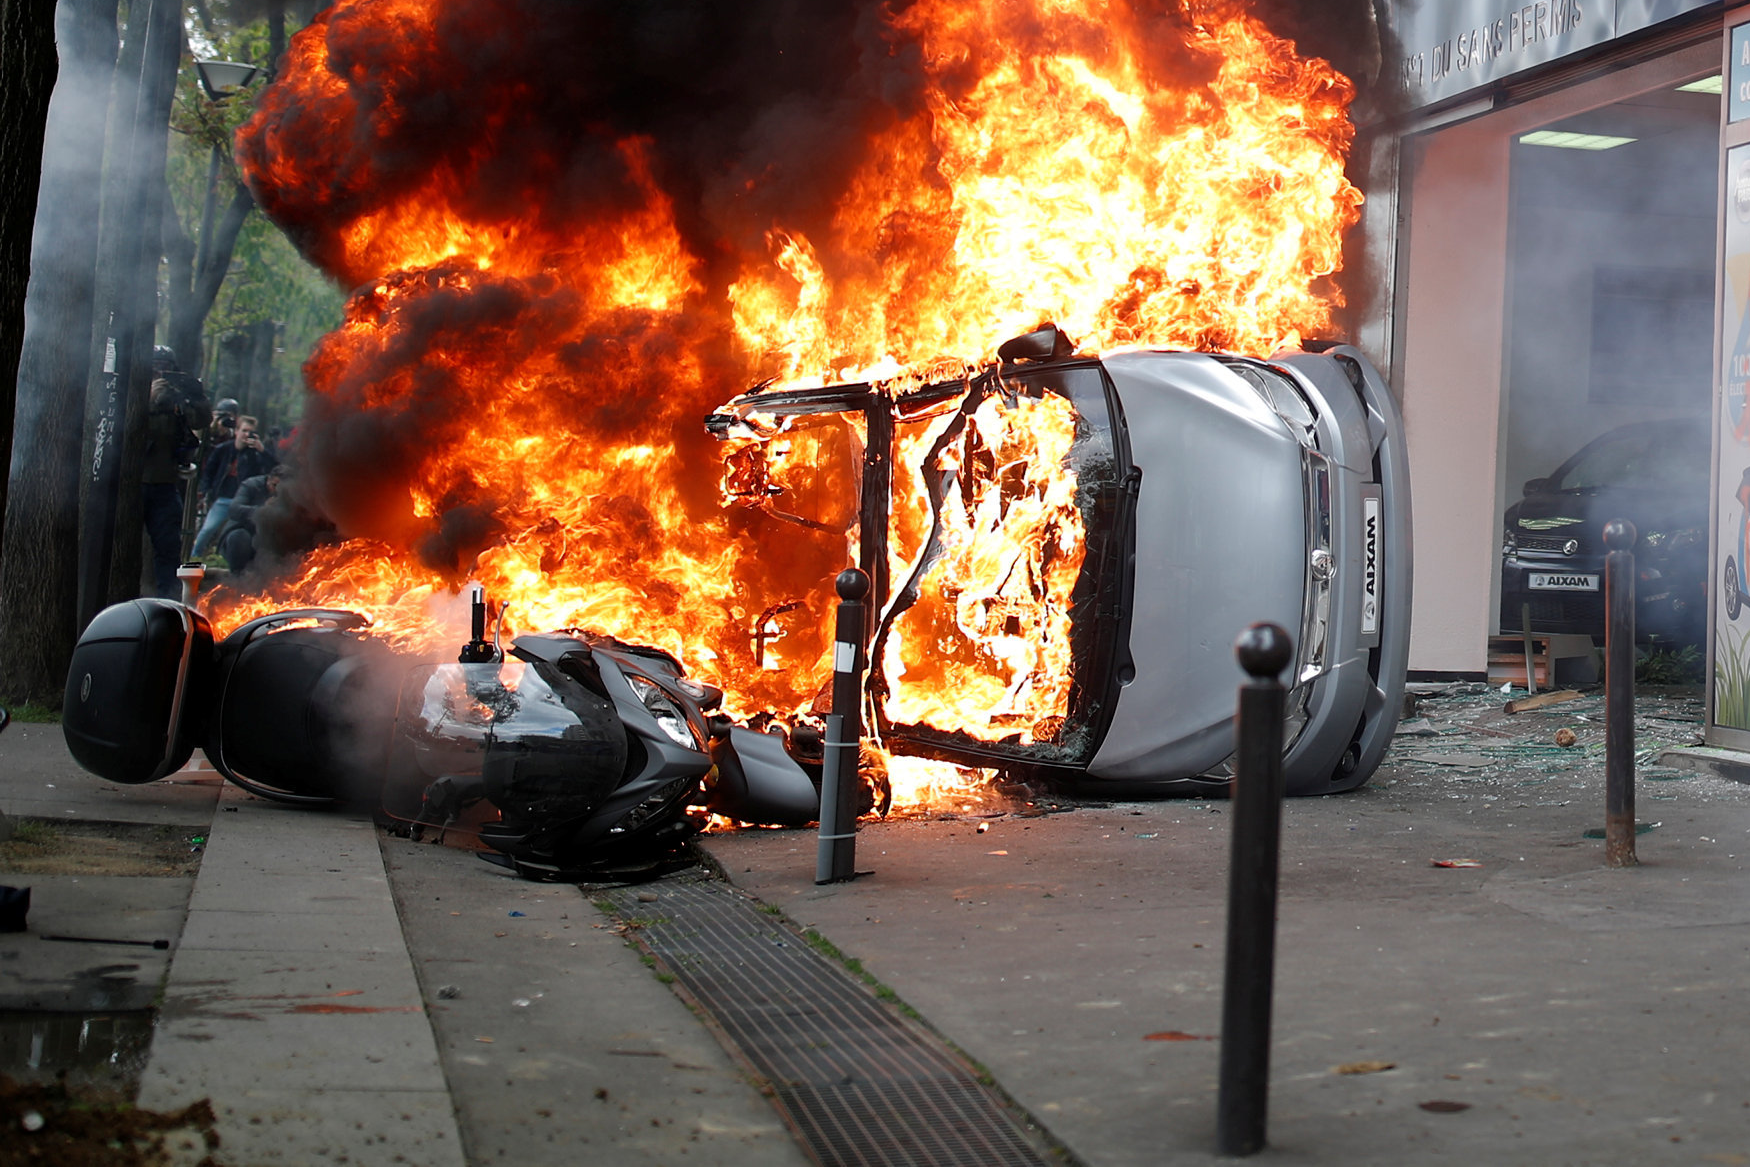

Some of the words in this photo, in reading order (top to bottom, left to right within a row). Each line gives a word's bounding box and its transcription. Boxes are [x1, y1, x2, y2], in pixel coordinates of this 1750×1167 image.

[1432, 40, 1452, 83] DU
[1456, 18, 1504, 72] SANS
[1366, 515, 1376, 596] AIXAM
[1547, 576, 1590, 587] AIXAM
